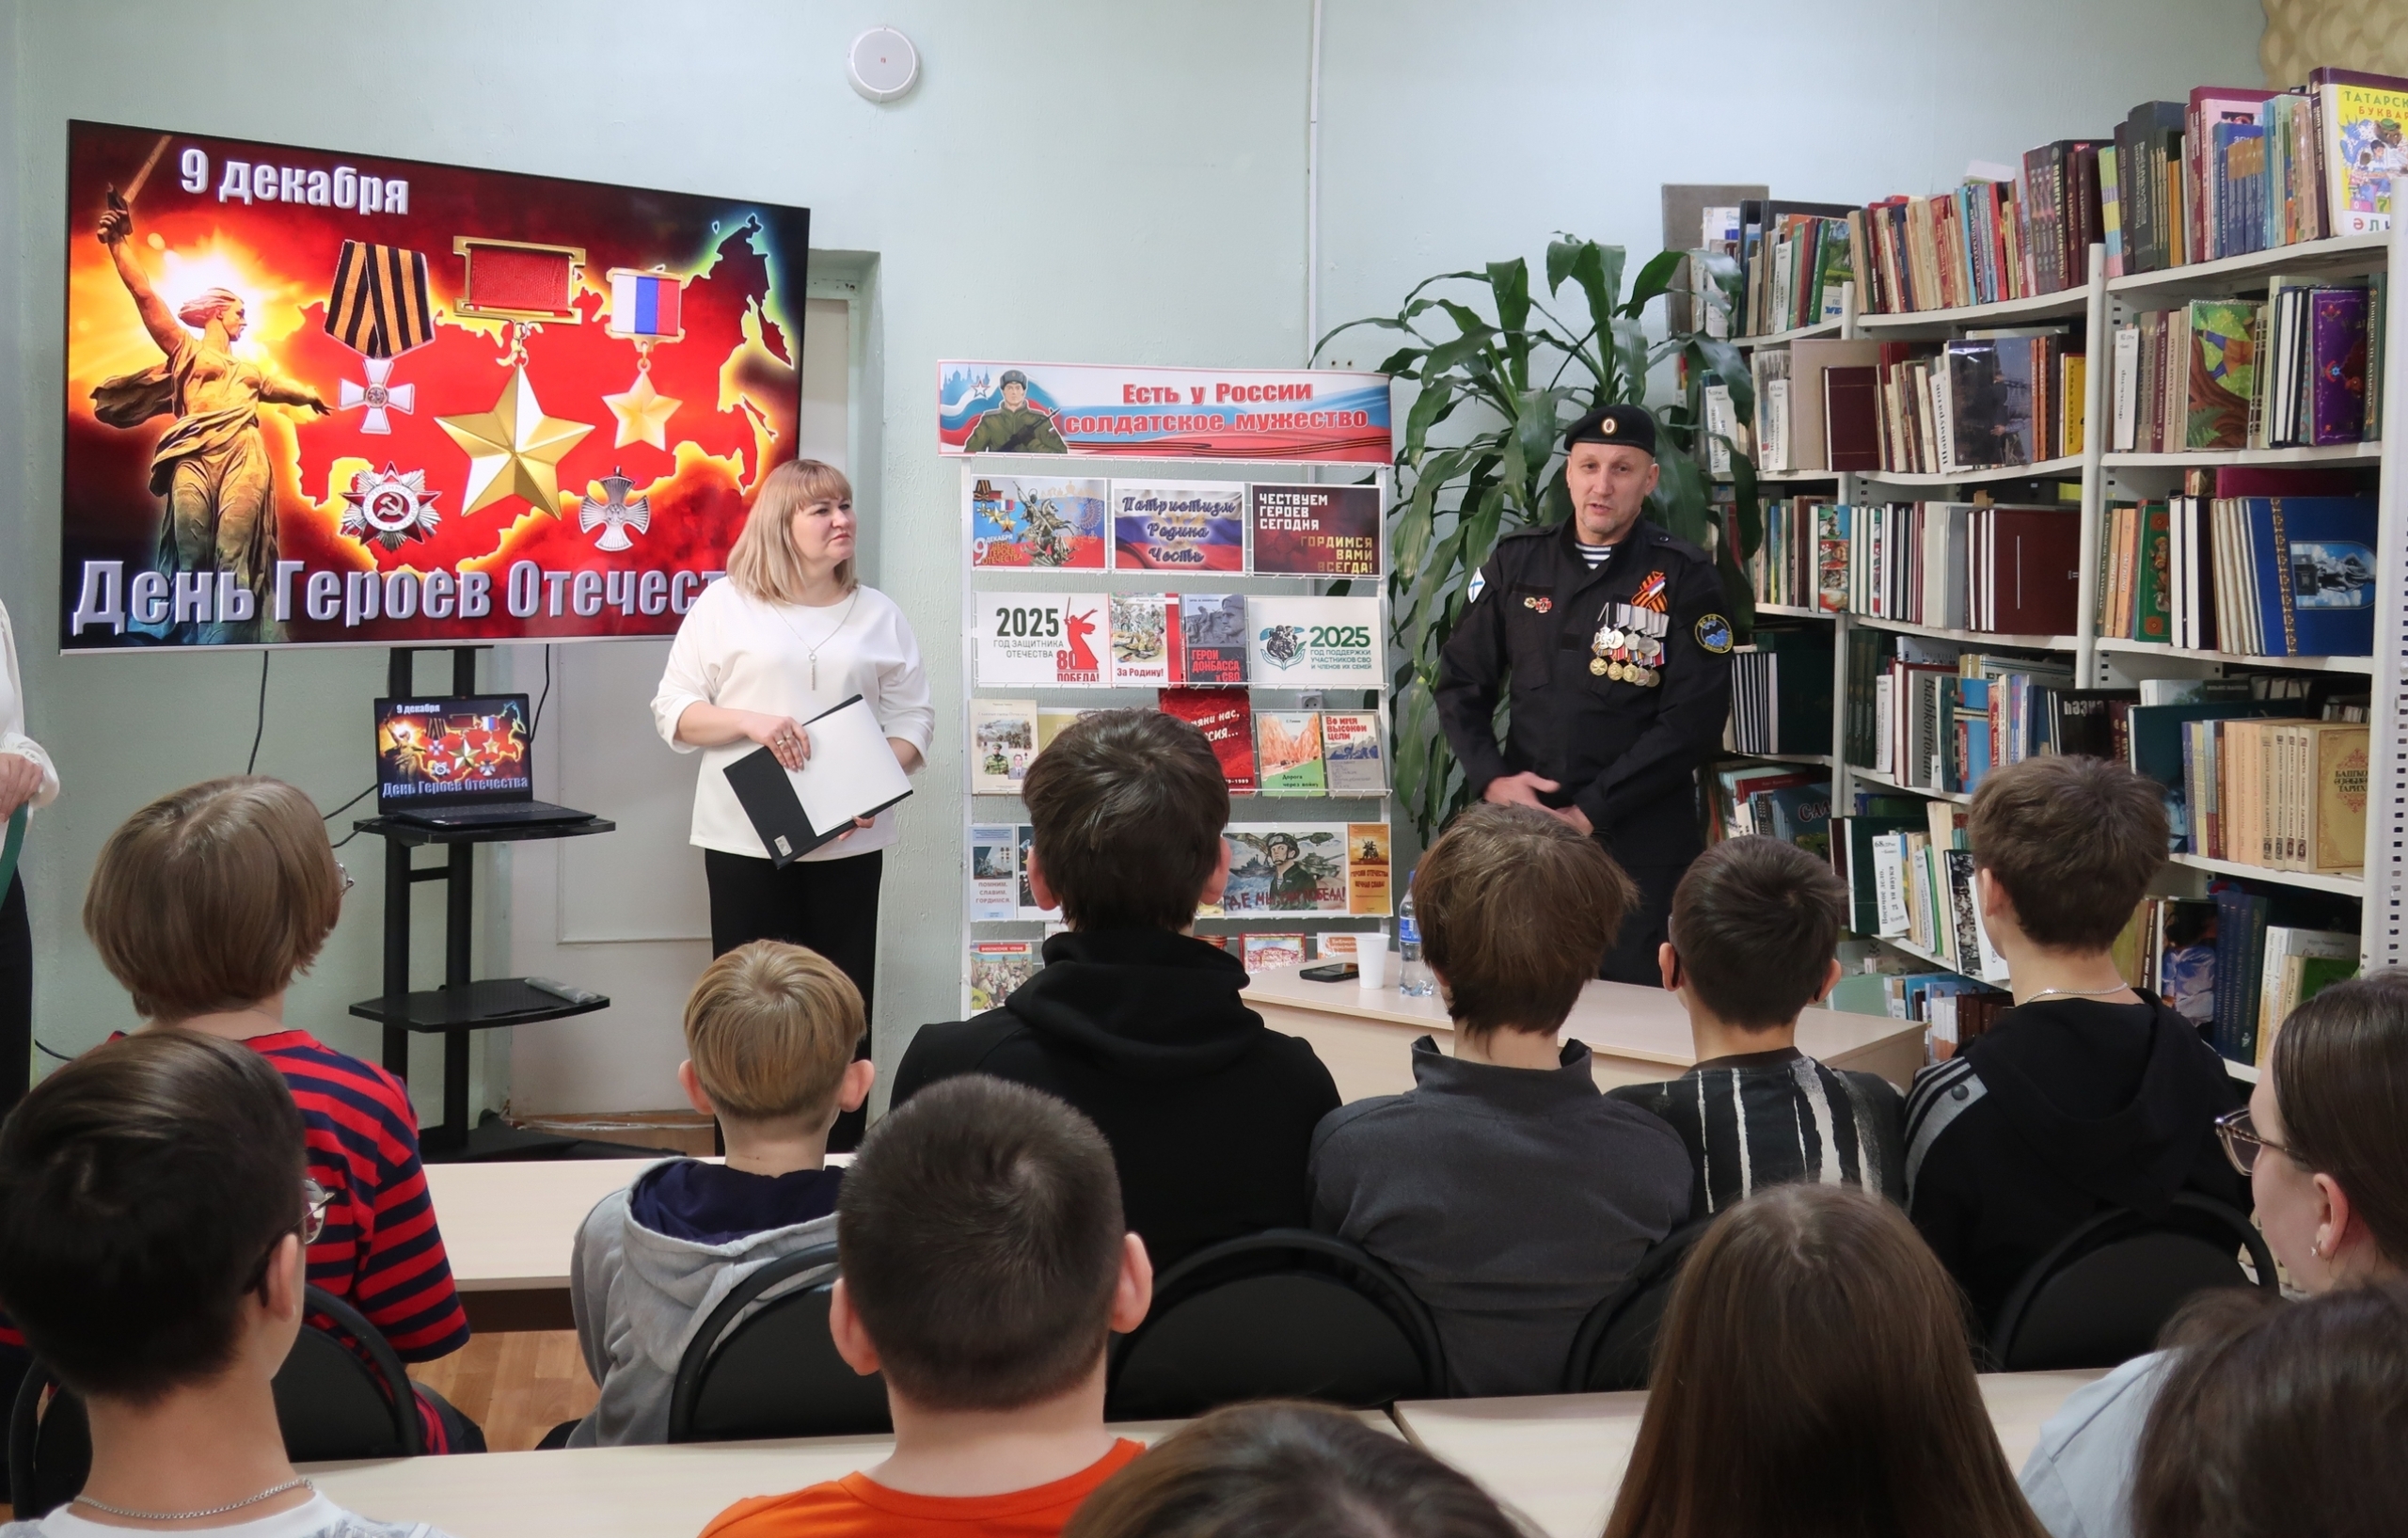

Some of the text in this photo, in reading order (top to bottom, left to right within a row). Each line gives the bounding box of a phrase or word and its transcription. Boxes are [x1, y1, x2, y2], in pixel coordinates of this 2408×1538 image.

[2345, 90, 2408, 110] ТАТАРСК
[181, 148, 409, 215] 9 декабря
[1122, 383, 1313, 405] Есть у России
[1064, 410, 1369, 436] солдатское мужество
[1121, 496, 1237, 516] Патриотизм
[1259, 493, 1329, 506] ЧЕСТВУЕМ
[1259, 506, 1310, 518] ГЕРОЕВ
[1147, 522, 1211, 542] Родина
[1259, 518, 1319, 531] СЕГОДНЯ
[1301, 536, 1373, 548] ГОРДИМСЯ
[973, 536, 989, 564] 9
[1149, 547, 1205, 563] Честь
[1336, 548, 1373, 561] ВАМИ
[1317, 562, 1373, 574] ВСЕГДА!
[72, 560, 256, 637] День
[275, 560, 491, 627] Героев
[996, 608, 1060, 637] 2025
[993, 640, 1064, 649] ГОД ЗАЩИТНИКА
[1308, 626, 1371, 648] 2025
[1006, 650, 1054, 658] ОТЕЧЕСТВА
[1056, 650, 1077, 670] 80
[1191, 649, 1219, 661] ГЕРОИ
[1117, 668, 1164, 678] За Родину!
[1192, 659, 1241, 674] ДОНБАССА
[1057, 673, 1100, 684] ПОБЕДА!
[1222, 672, 1241, 683] СВО
[396, 704, 440, 715] 9 декабря
[1218, 709, 1241, 721] нас,
[1326, 717, 1338, 725] Во
[1923, 677, 1937, 781] Bashkortostan
[382, 776, 529, 799] День Героев Отечества
[1223, 892, 1253, 912] ГДЕ
